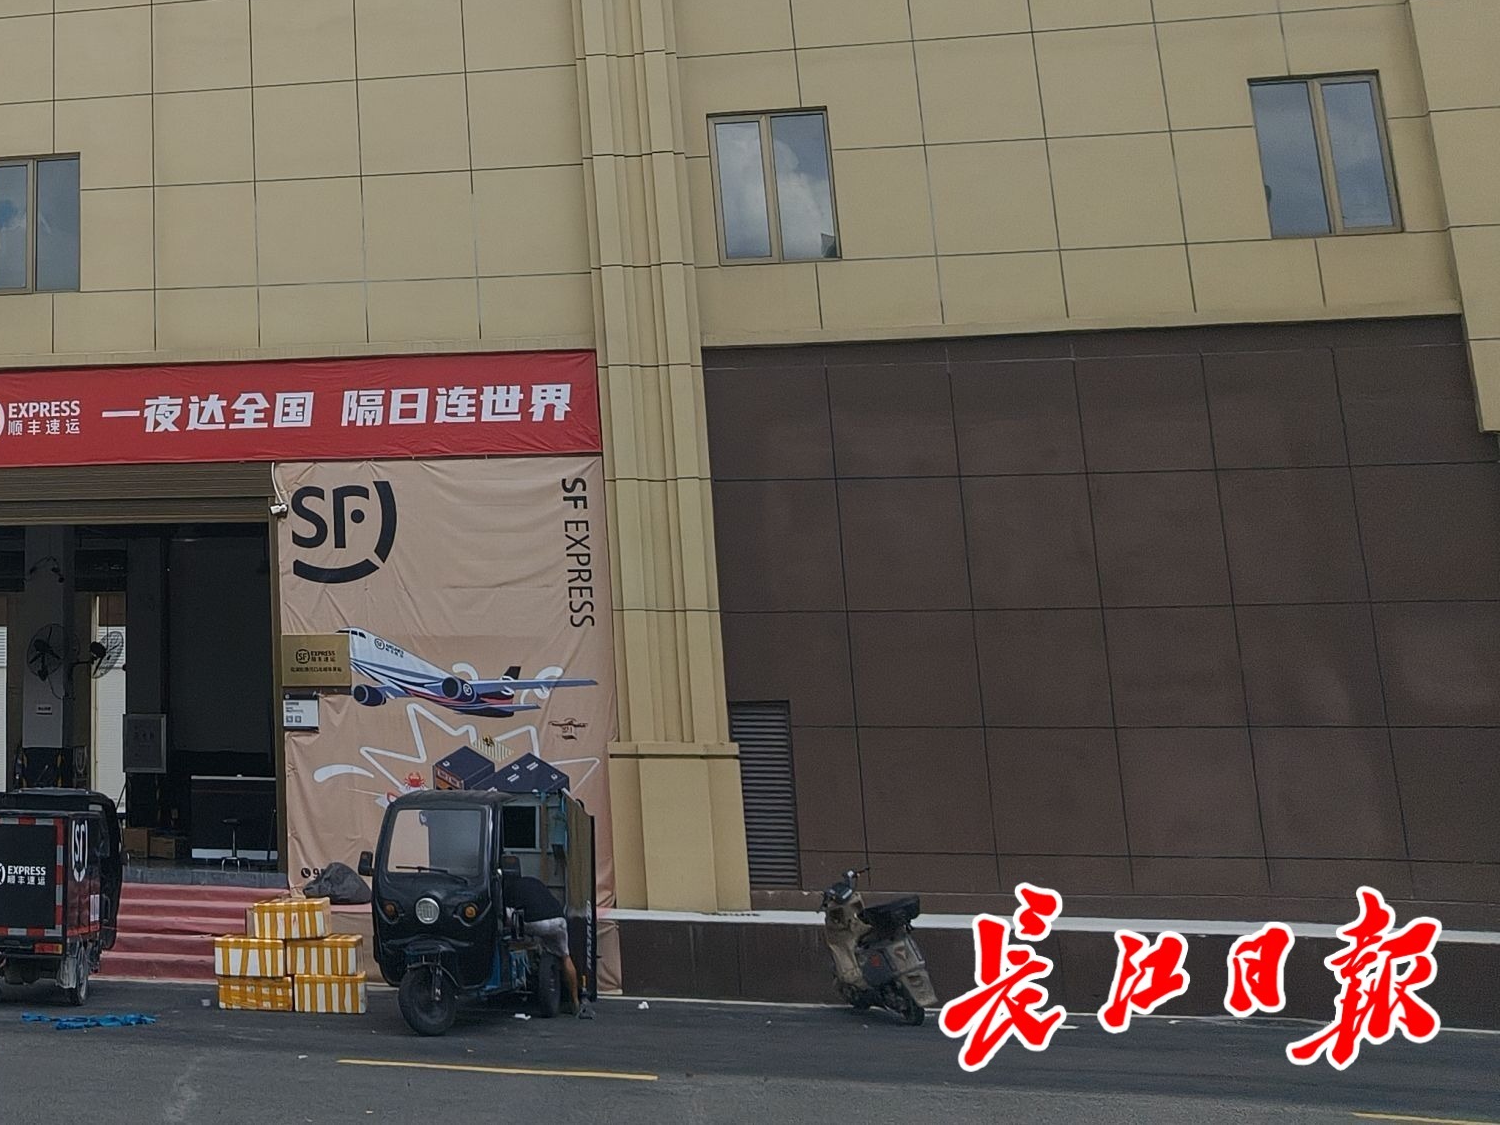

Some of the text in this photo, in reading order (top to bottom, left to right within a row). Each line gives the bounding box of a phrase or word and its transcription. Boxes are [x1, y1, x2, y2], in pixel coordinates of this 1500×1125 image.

[8, 400, 80, 418] EXPRESS
[102, 383, 572, 432] 一夜达全国 隔日连世界
[7, 419, 80, 435] 顺丰速运
[561, 477, 595, 627] SF EXPRESS
[7, 865, 46, 876] EXPRESS
